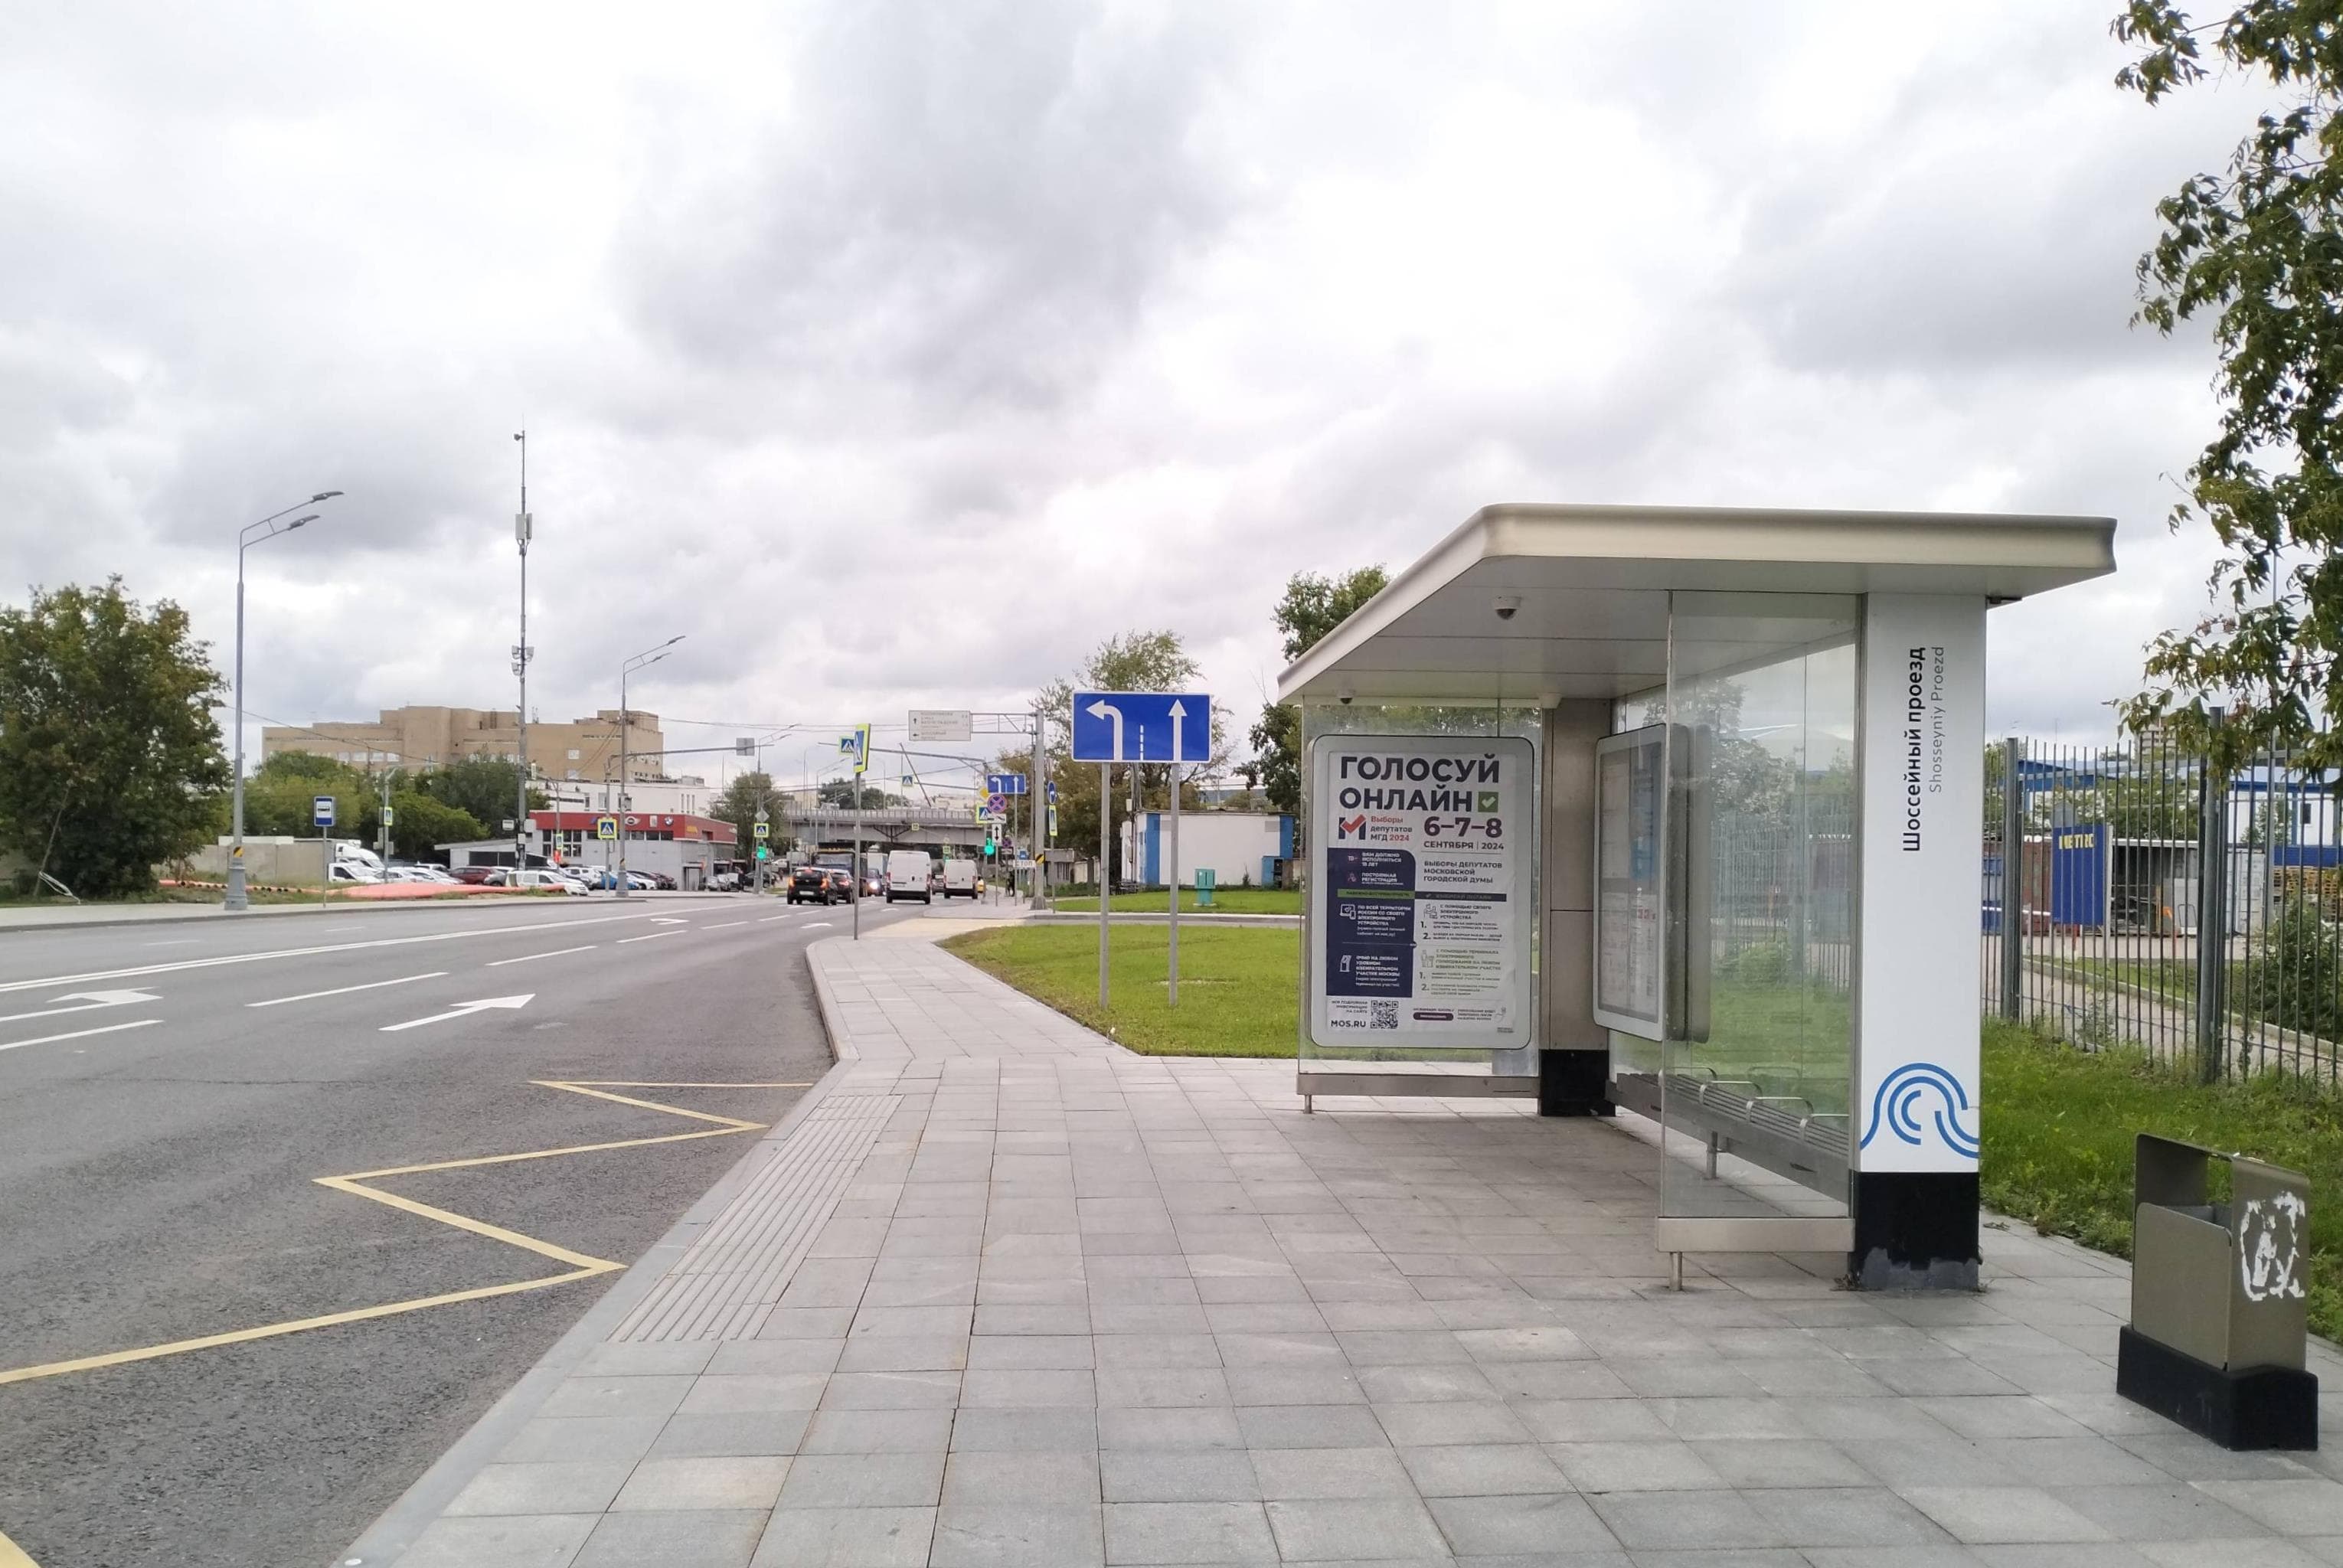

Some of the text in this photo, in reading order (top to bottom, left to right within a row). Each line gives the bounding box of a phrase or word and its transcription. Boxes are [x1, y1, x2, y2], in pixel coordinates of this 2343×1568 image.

[1930, 646, 1946, 793] Shosseyniy Proezd
[1903, 647, 1926, 851] Шоссейный проезд
[1341, 753, 1500, 783] ГОЛОСУЙ
[1339, 784, 1472, 812] ОНЛАЙН
[1371, 815, 1404, 824] Выборы
[1423, 841, 1474, 849] СЕНТЯБРЯ
